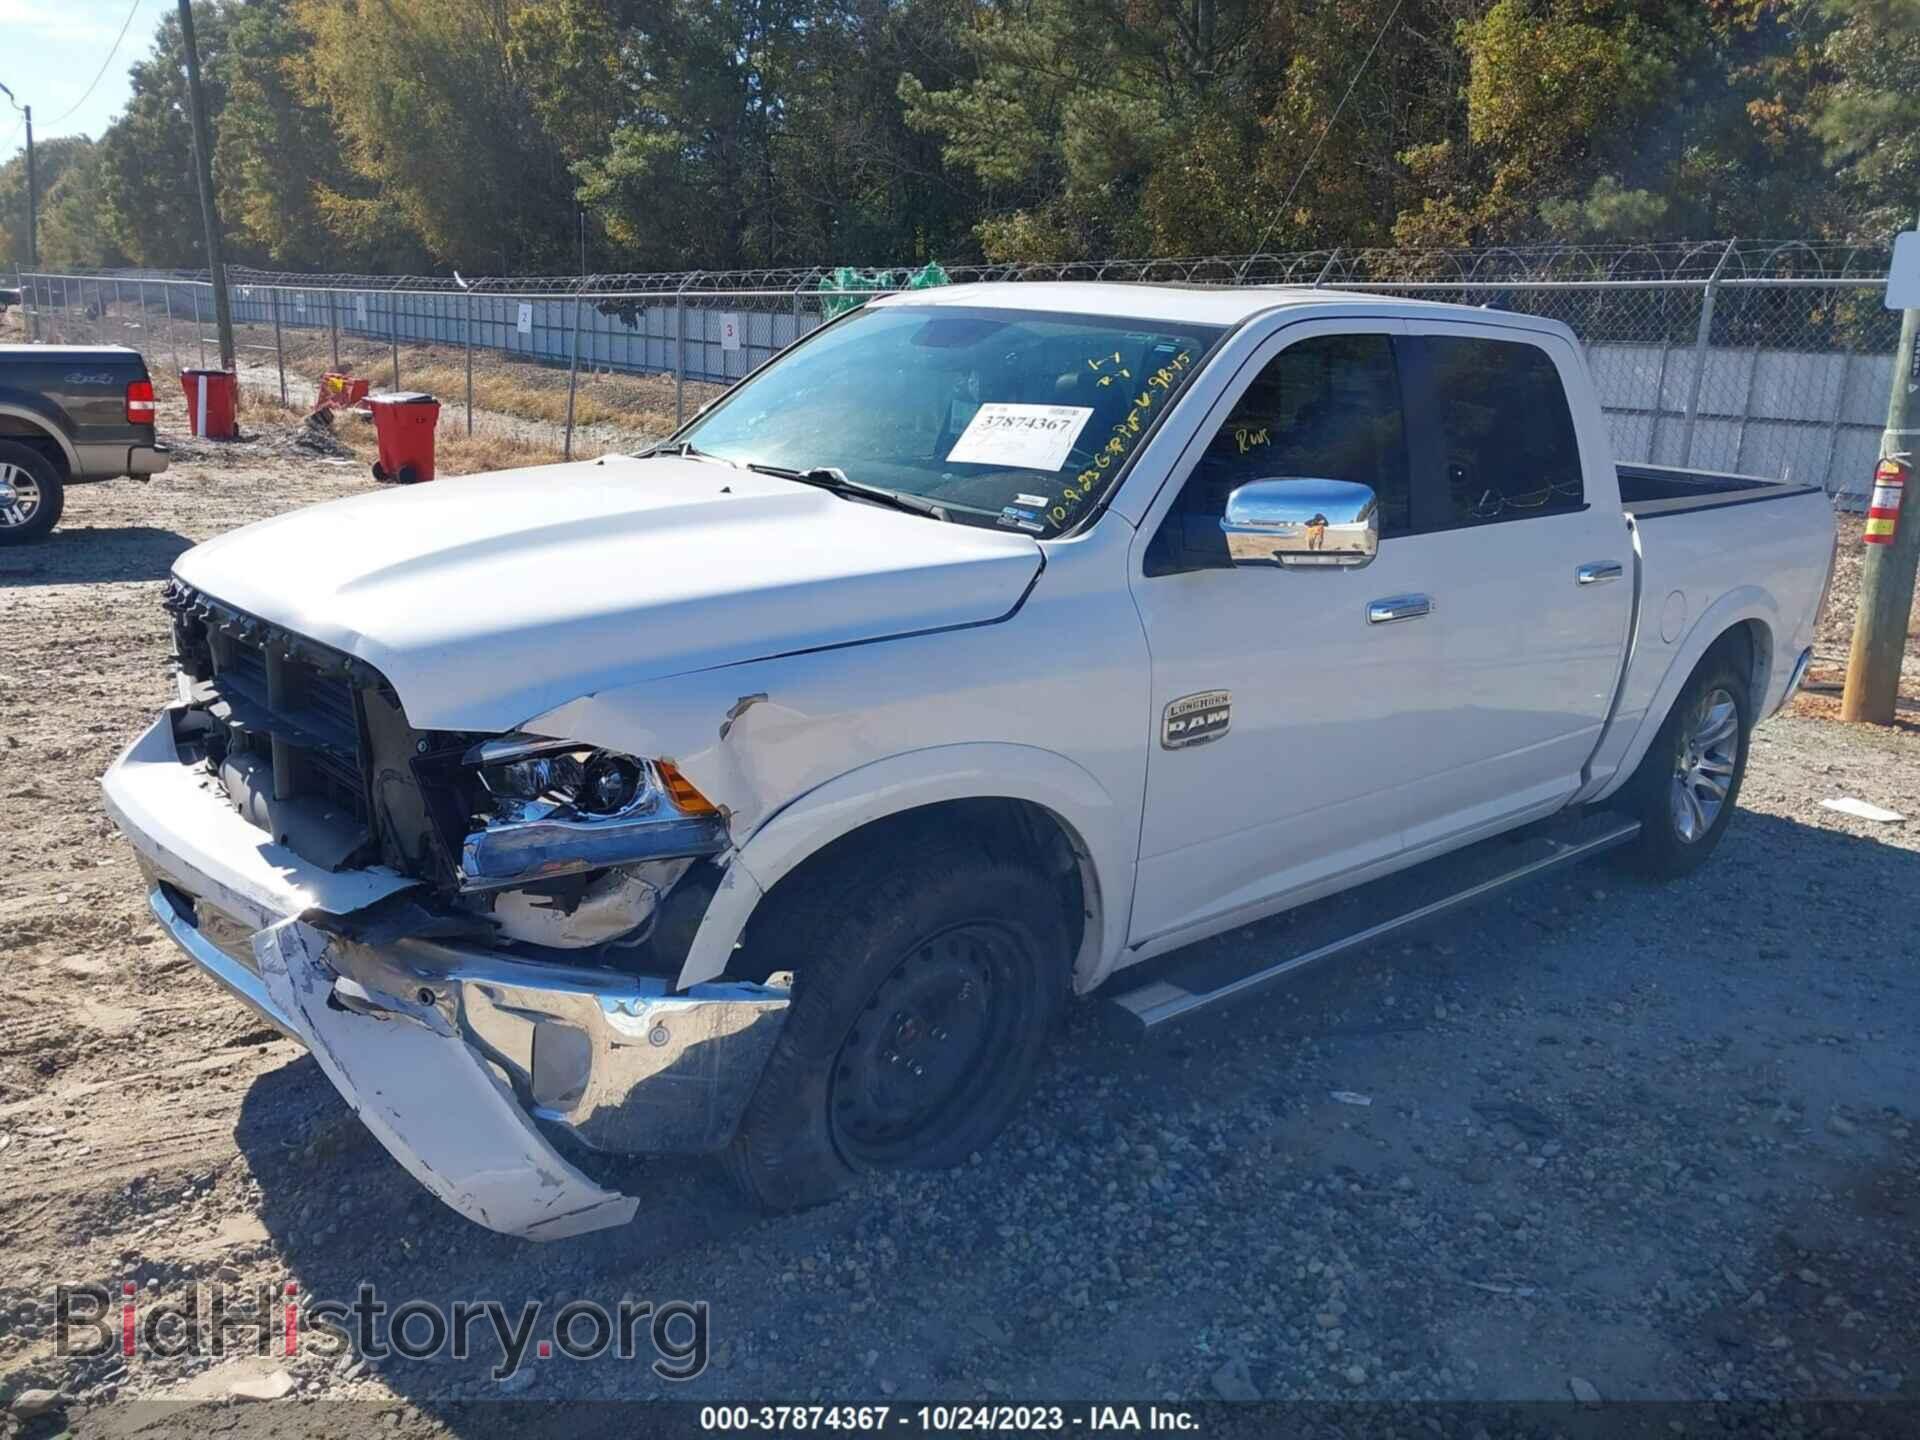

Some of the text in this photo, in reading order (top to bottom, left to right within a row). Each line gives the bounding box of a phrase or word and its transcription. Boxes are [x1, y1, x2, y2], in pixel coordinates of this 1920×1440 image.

[726, 323, 734, 338] 3
[979, 415, 1072, 433] 37874367
[1168, 710, 1229, 733] RAM
